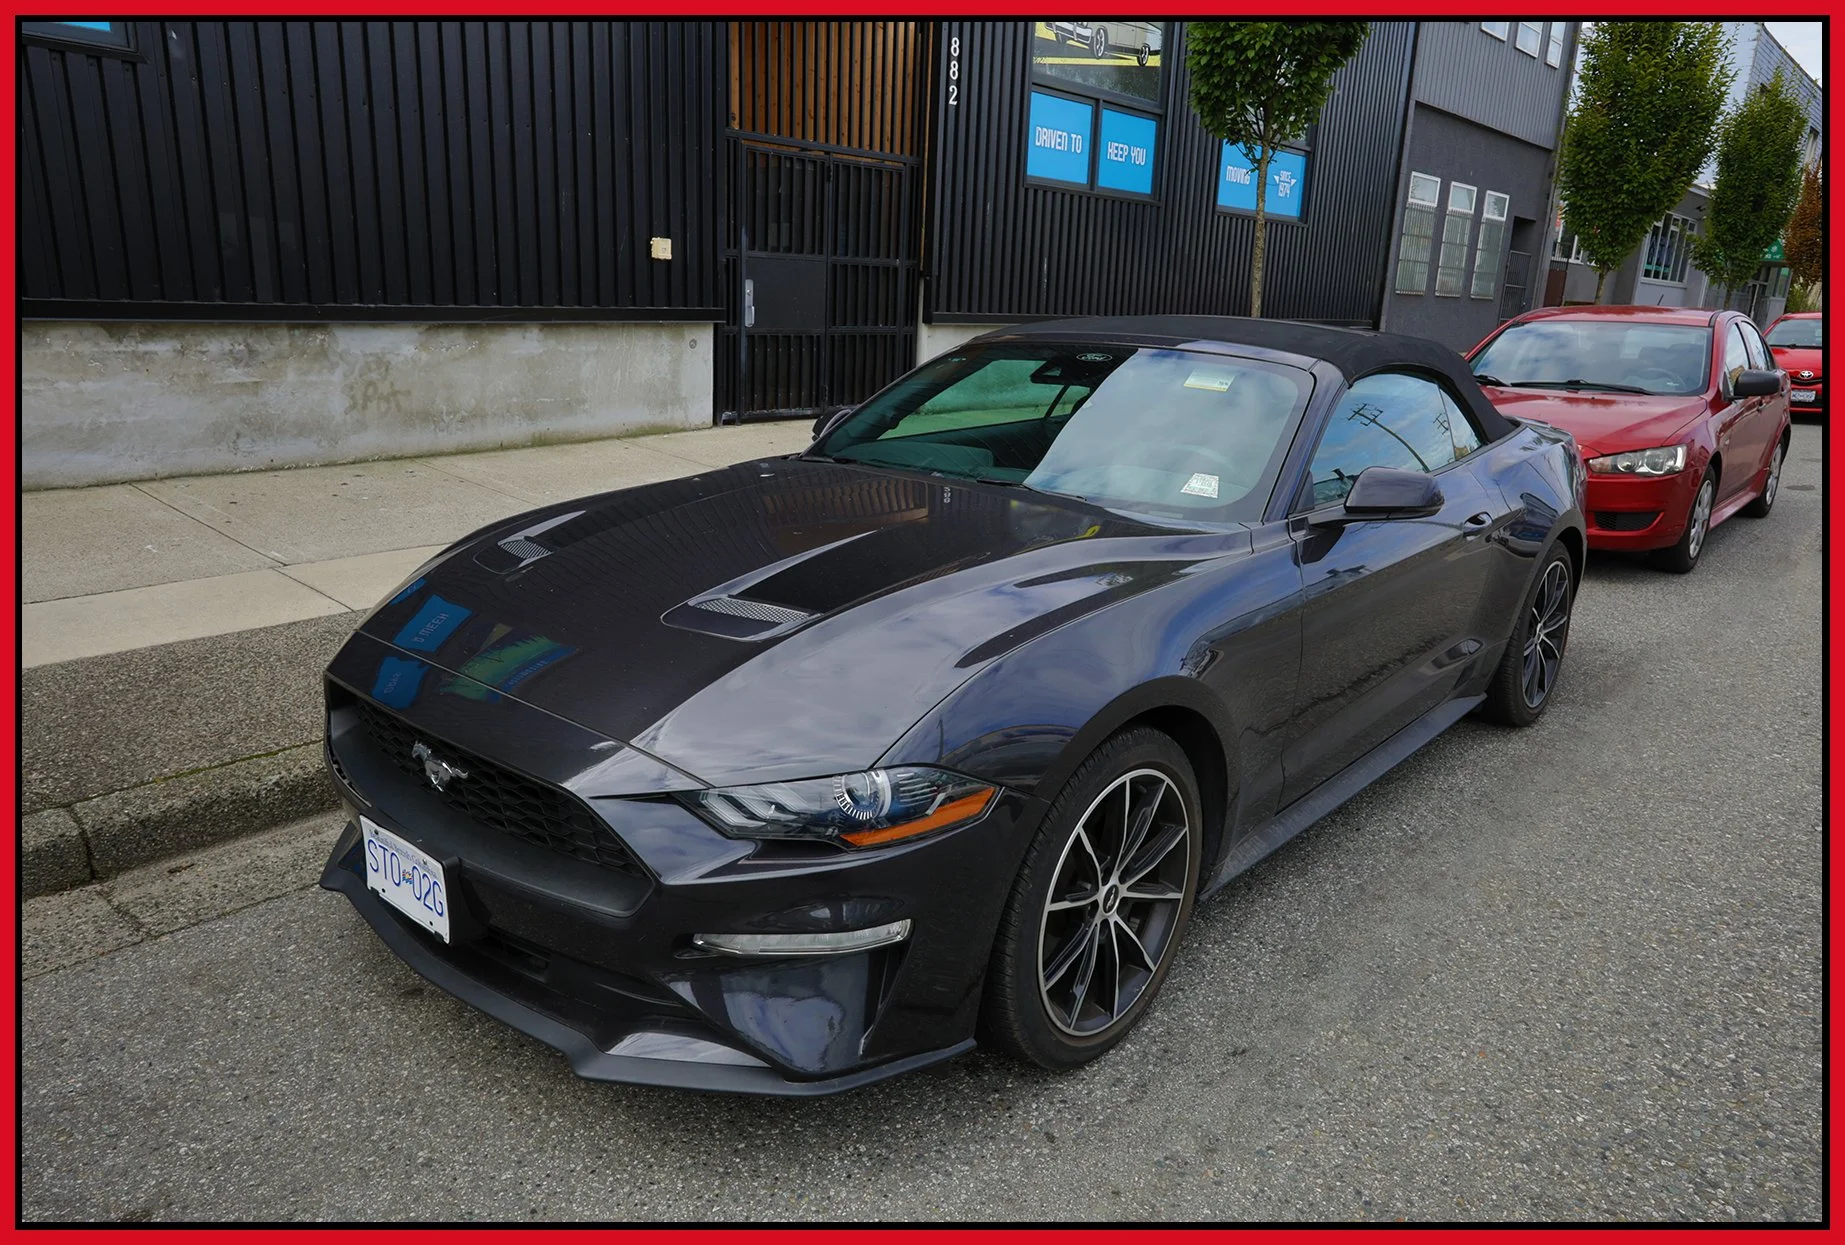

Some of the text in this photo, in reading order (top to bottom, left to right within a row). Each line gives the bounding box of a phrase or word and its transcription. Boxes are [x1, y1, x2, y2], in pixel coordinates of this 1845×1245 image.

[948, 36, 960, 106] 882
[1035, 126, 1083, 154] DRIVEN TO
[1107, 141, 1147, 166] KEEP YOU
